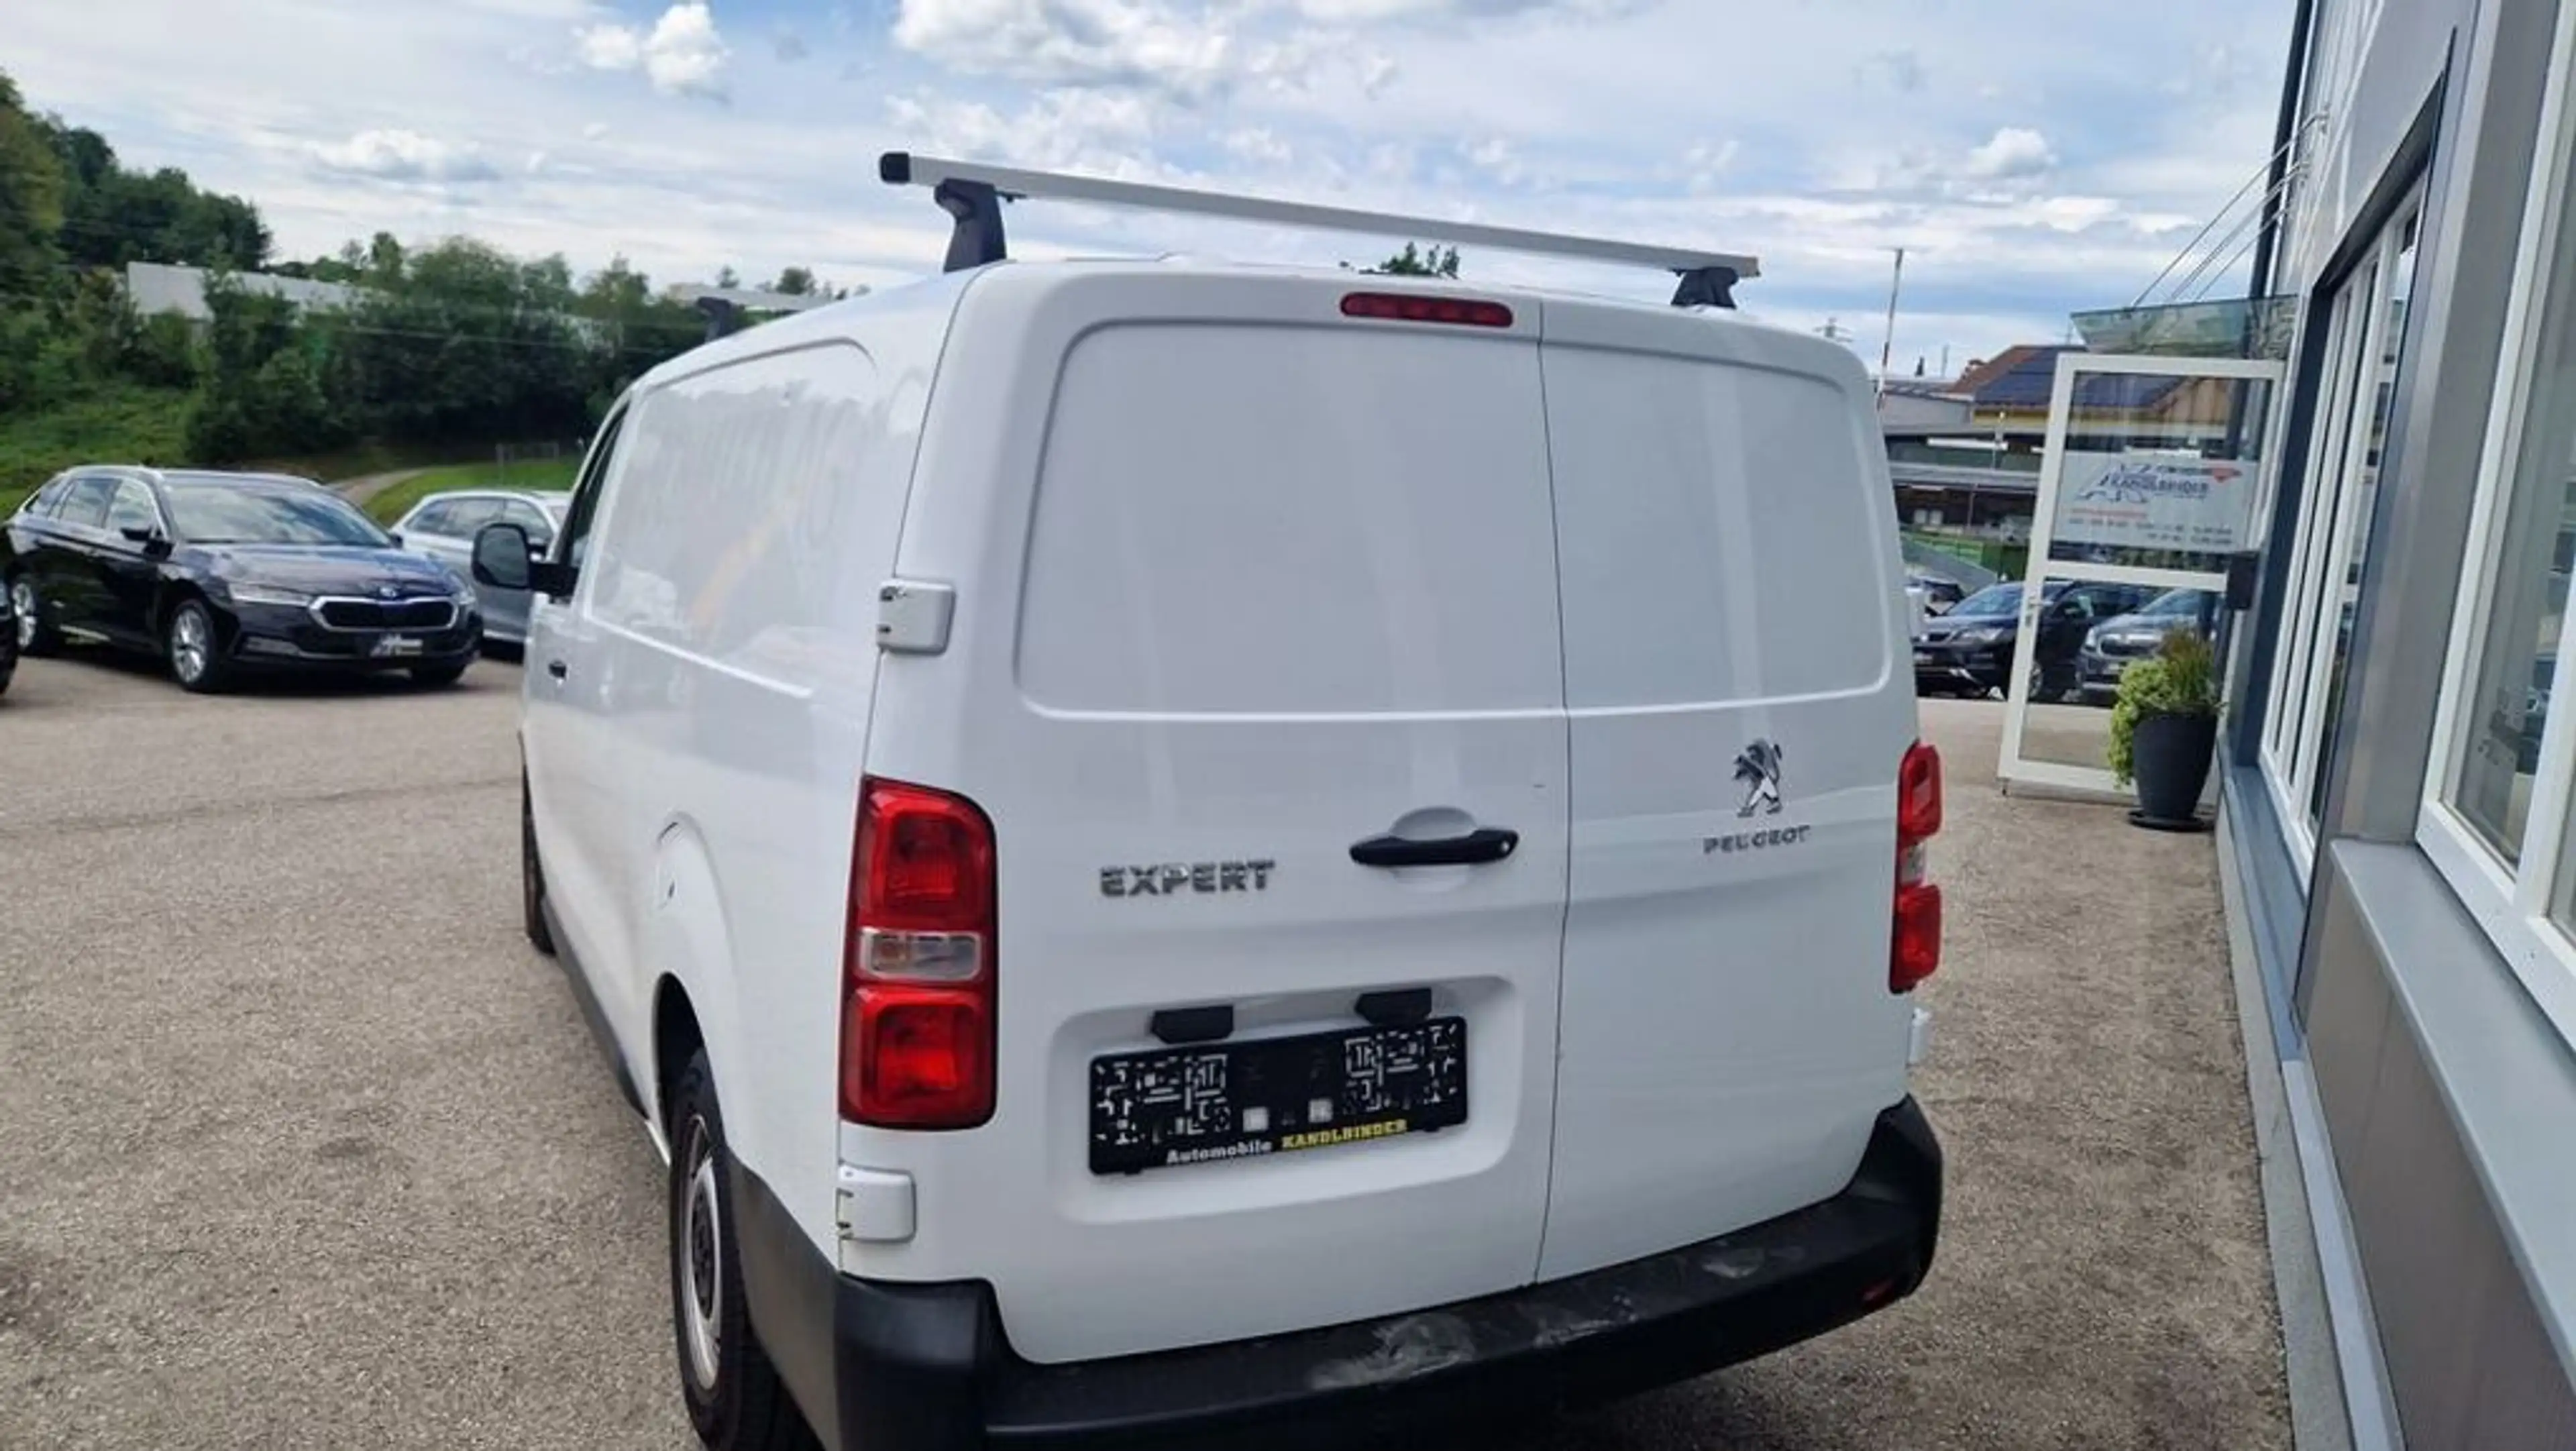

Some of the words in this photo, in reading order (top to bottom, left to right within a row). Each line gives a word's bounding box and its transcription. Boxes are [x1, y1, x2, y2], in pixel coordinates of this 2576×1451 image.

[1703, 824, 1811, 854] PEUGEOT
[1099, 859, 1276, 897] EXPERT
[1166, 1140, 1273, 1164] Automobile
[1281, 1119, 1408, 1150] KANDLBINDER
